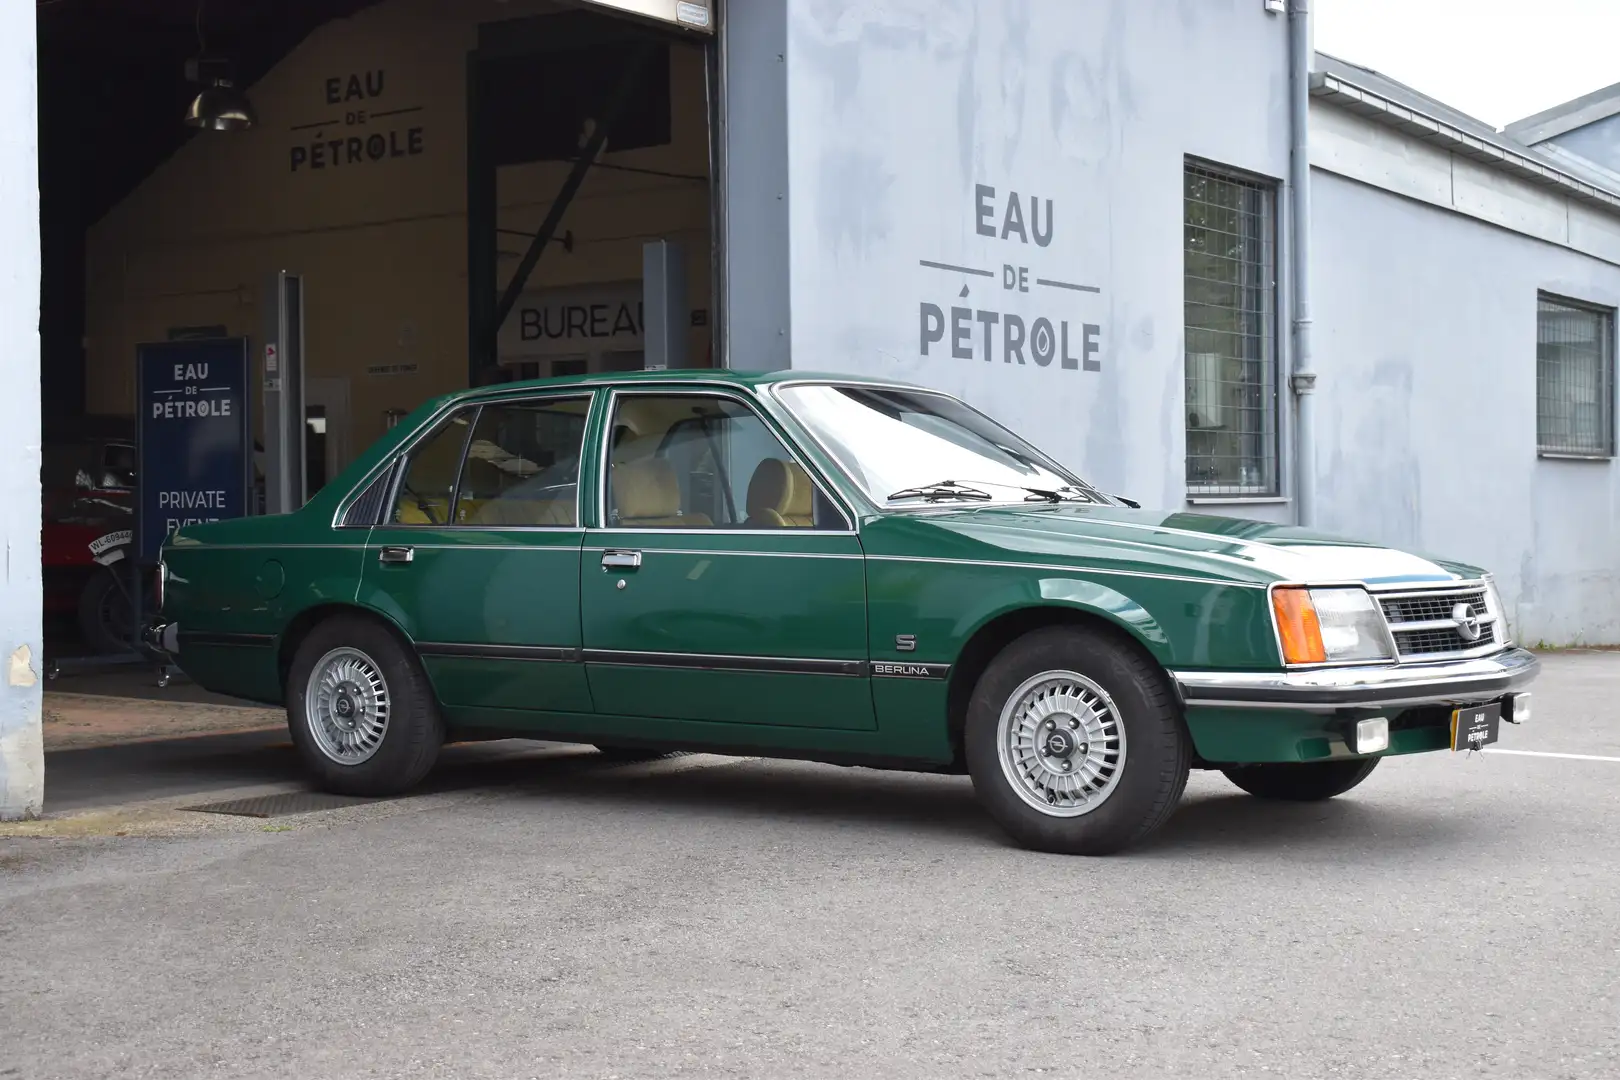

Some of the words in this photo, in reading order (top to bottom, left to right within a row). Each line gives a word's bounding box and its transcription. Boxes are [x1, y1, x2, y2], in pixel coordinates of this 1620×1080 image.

[326, 69, 384, 104] EAU
[345, 110, 367, 125] DE
[290, 127, 424, 172] PÉTROLE
[975, 183, 1053, 247] EAU
[1003, 263, 1029, 293] DE
[520, 302, 644, 341] BUREA
[919, 283, 1101, 372] PÉTROLE
[174, 362, 209, 381] EAU
[185, 385, 198, 395] DE
[153, 395, 231, 419] PÉTROLE
[159, 490, 226, 509] PRIVATE
[895, 634, 915, 651] S
[874, 664, 930, 676] BERLINA
[1474, 712, 1485, 723] EAU
